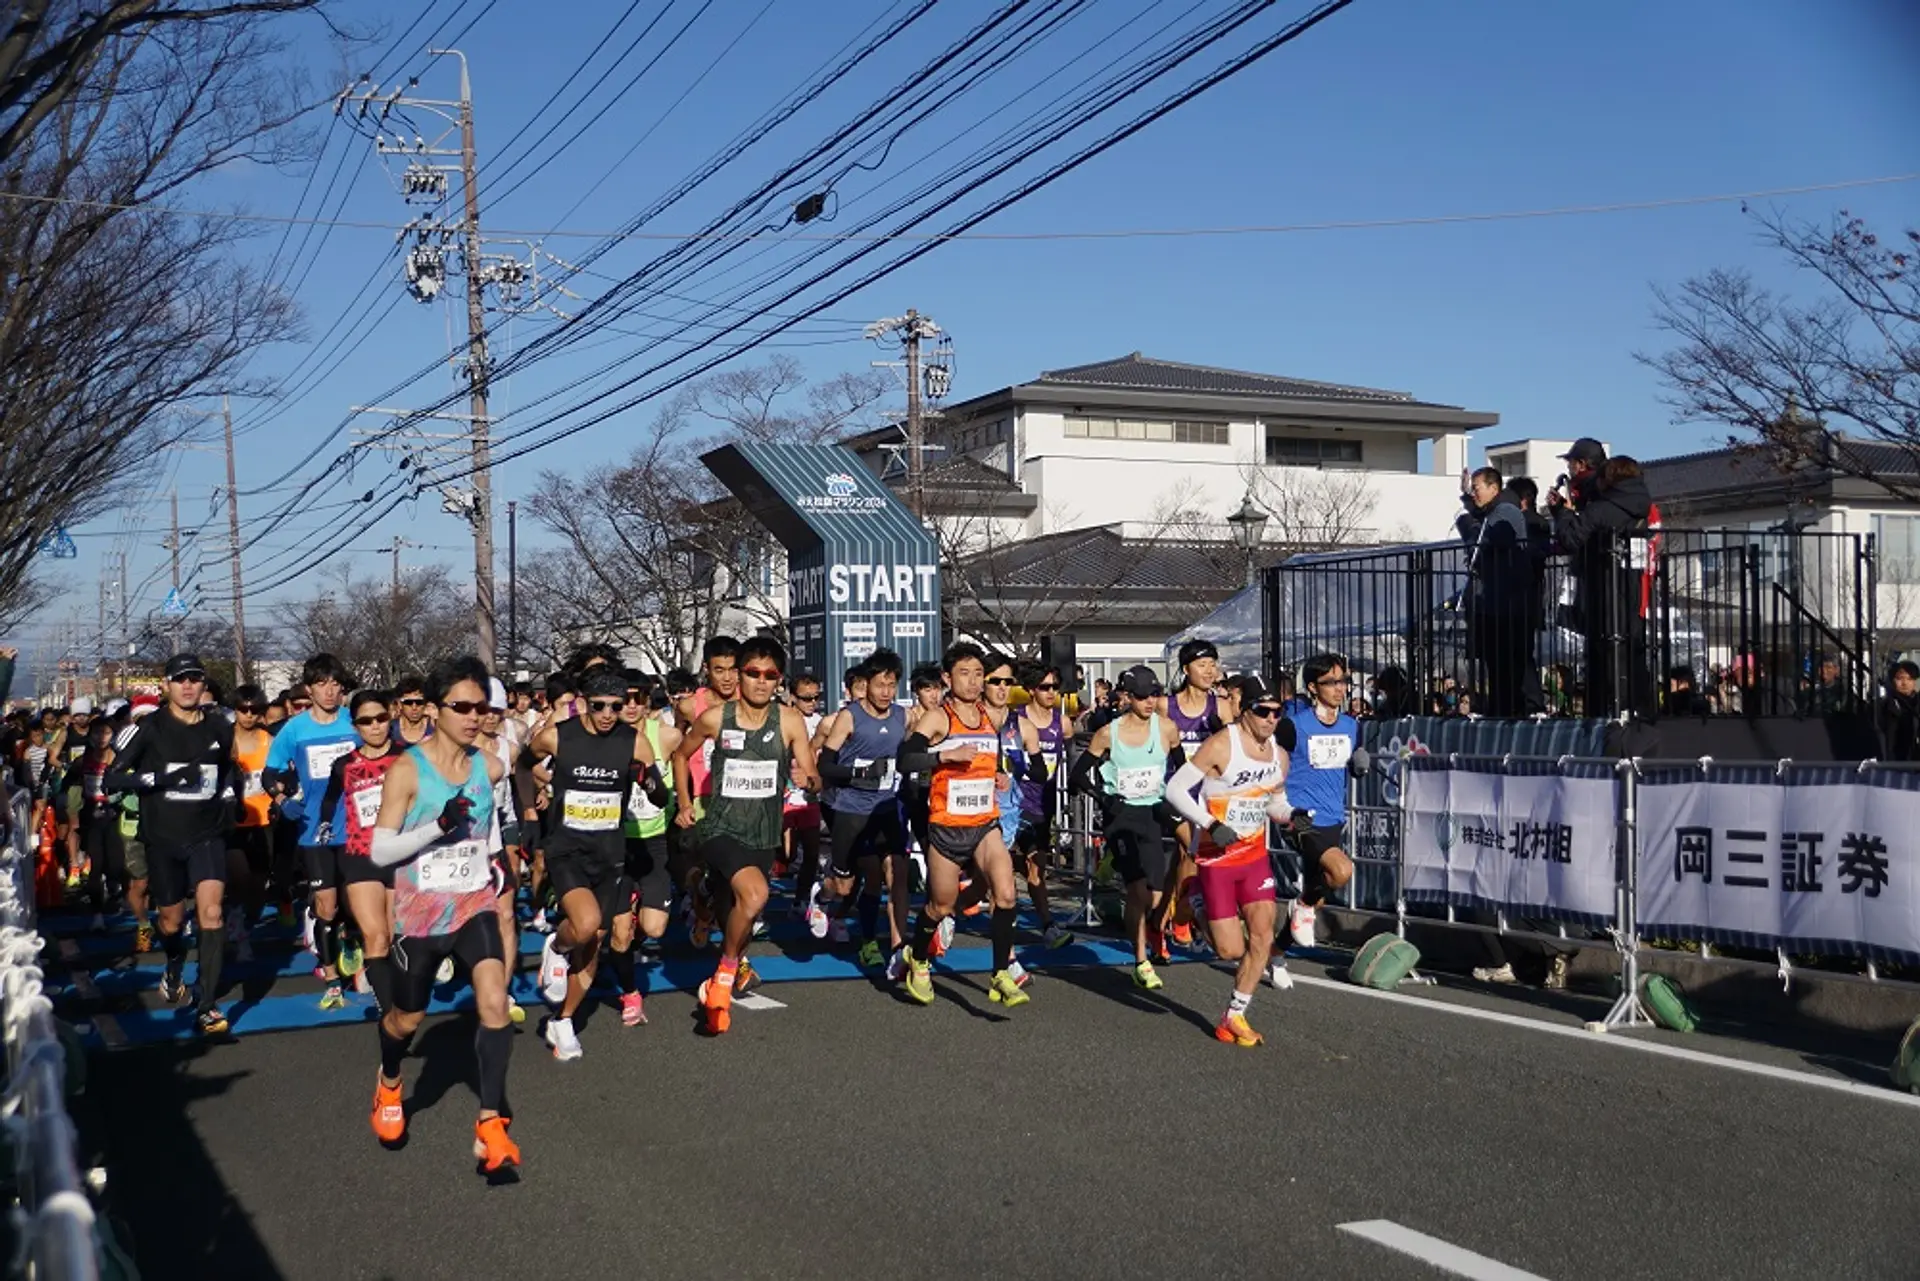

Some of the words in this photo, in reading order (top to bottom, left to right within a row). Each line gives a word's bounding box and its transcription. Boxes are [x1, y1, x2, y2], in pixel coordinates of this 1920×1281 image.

[789, 566, 824, 608] START
[829, 565, 936, 603] START
[583, 806, 608, 819] 503
[1462, 825, 1505, 850] 株式会社
[1509, 821, 1573, 864] 北村組
[1674, 826, 1889, 898] 岡三証券
[422, 864, 432, 880] S
[448, 861, 470, 879] 26
